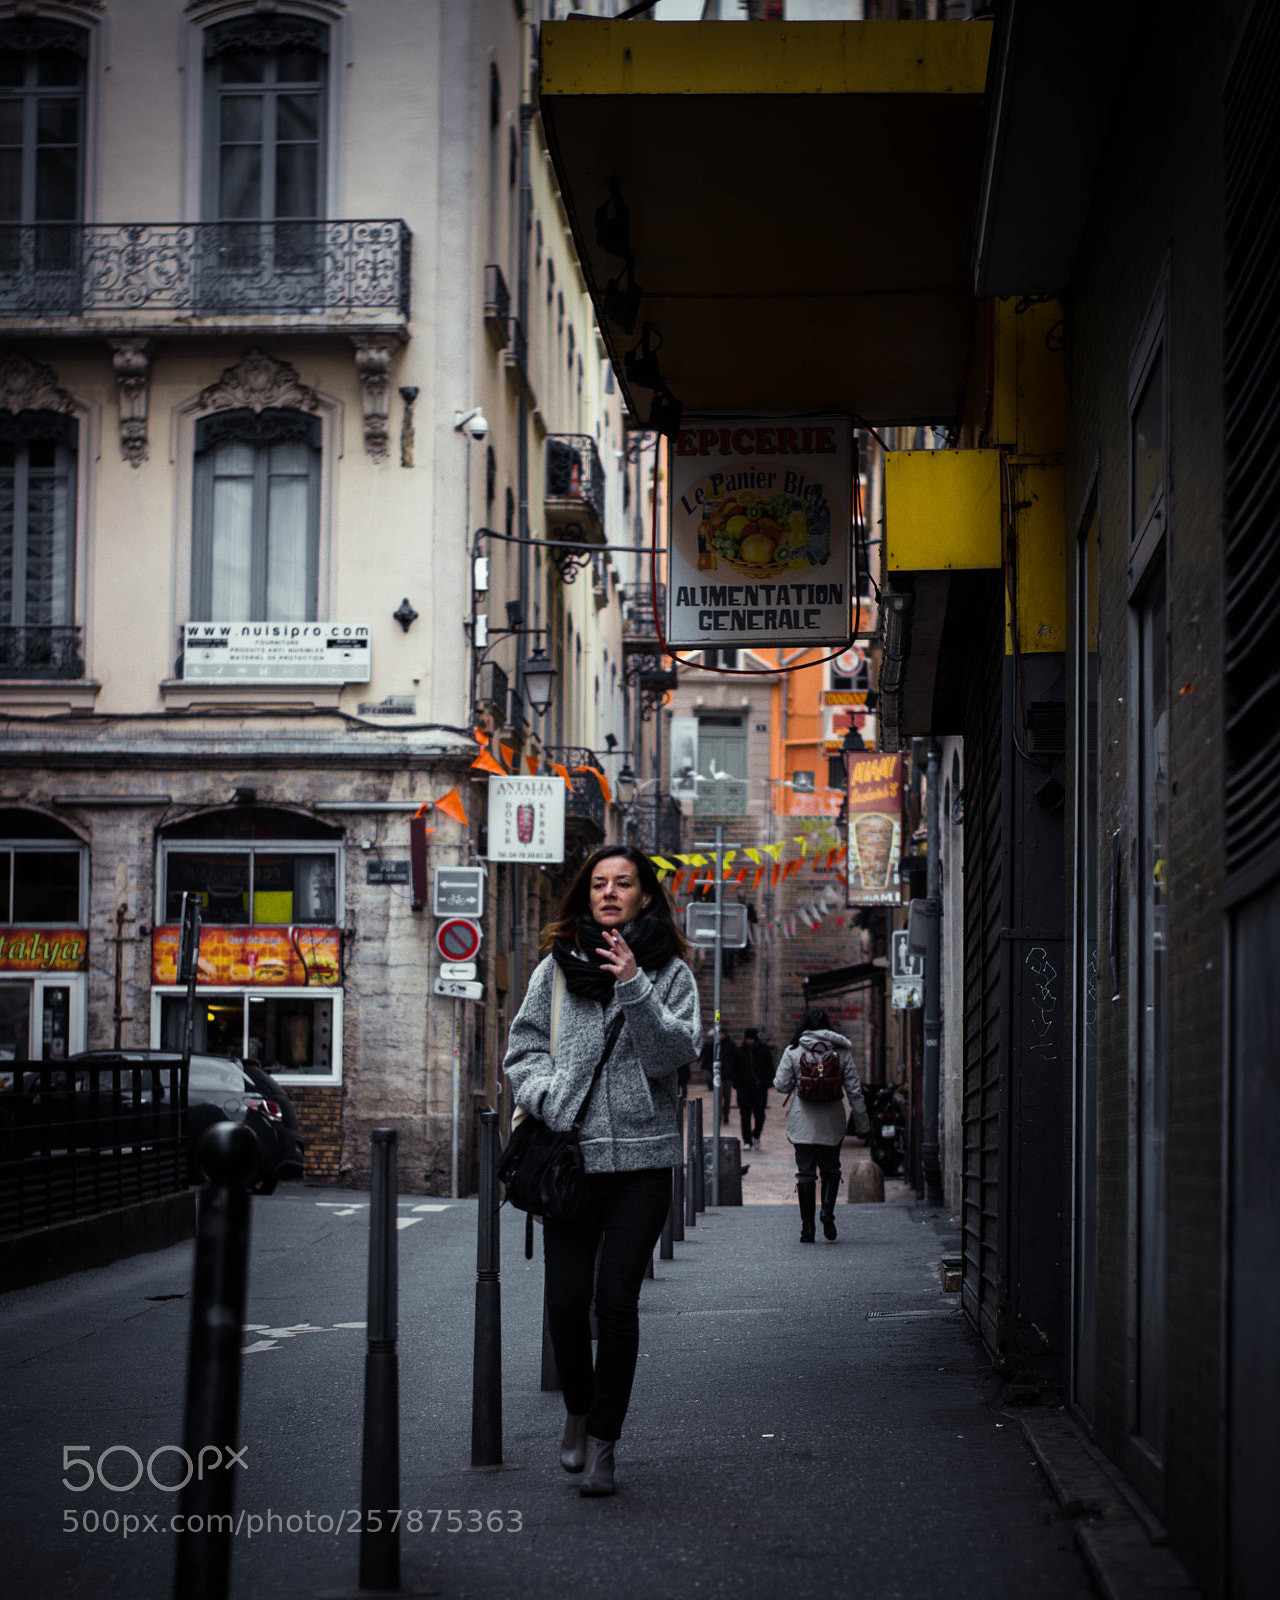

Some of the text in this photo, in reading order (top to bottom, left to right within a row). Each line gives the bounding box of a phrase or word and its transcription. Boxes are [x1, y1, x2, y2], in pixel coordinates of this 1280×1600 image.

[675, 426, 837, 455] EPICERIE
[680, 466, 828, 515] Le Panier Bleu
[676, 584, 843, 607] ALIMENTATION
[698, 609, 821, 631] GENERALE
[187, 625, 369, 638] www.nuisipro.com
[851, 756, 897, 786] MIAMI
[499, 782, 552, 791] ANTALIA
[862, 892, 900, 902] MIAMI
